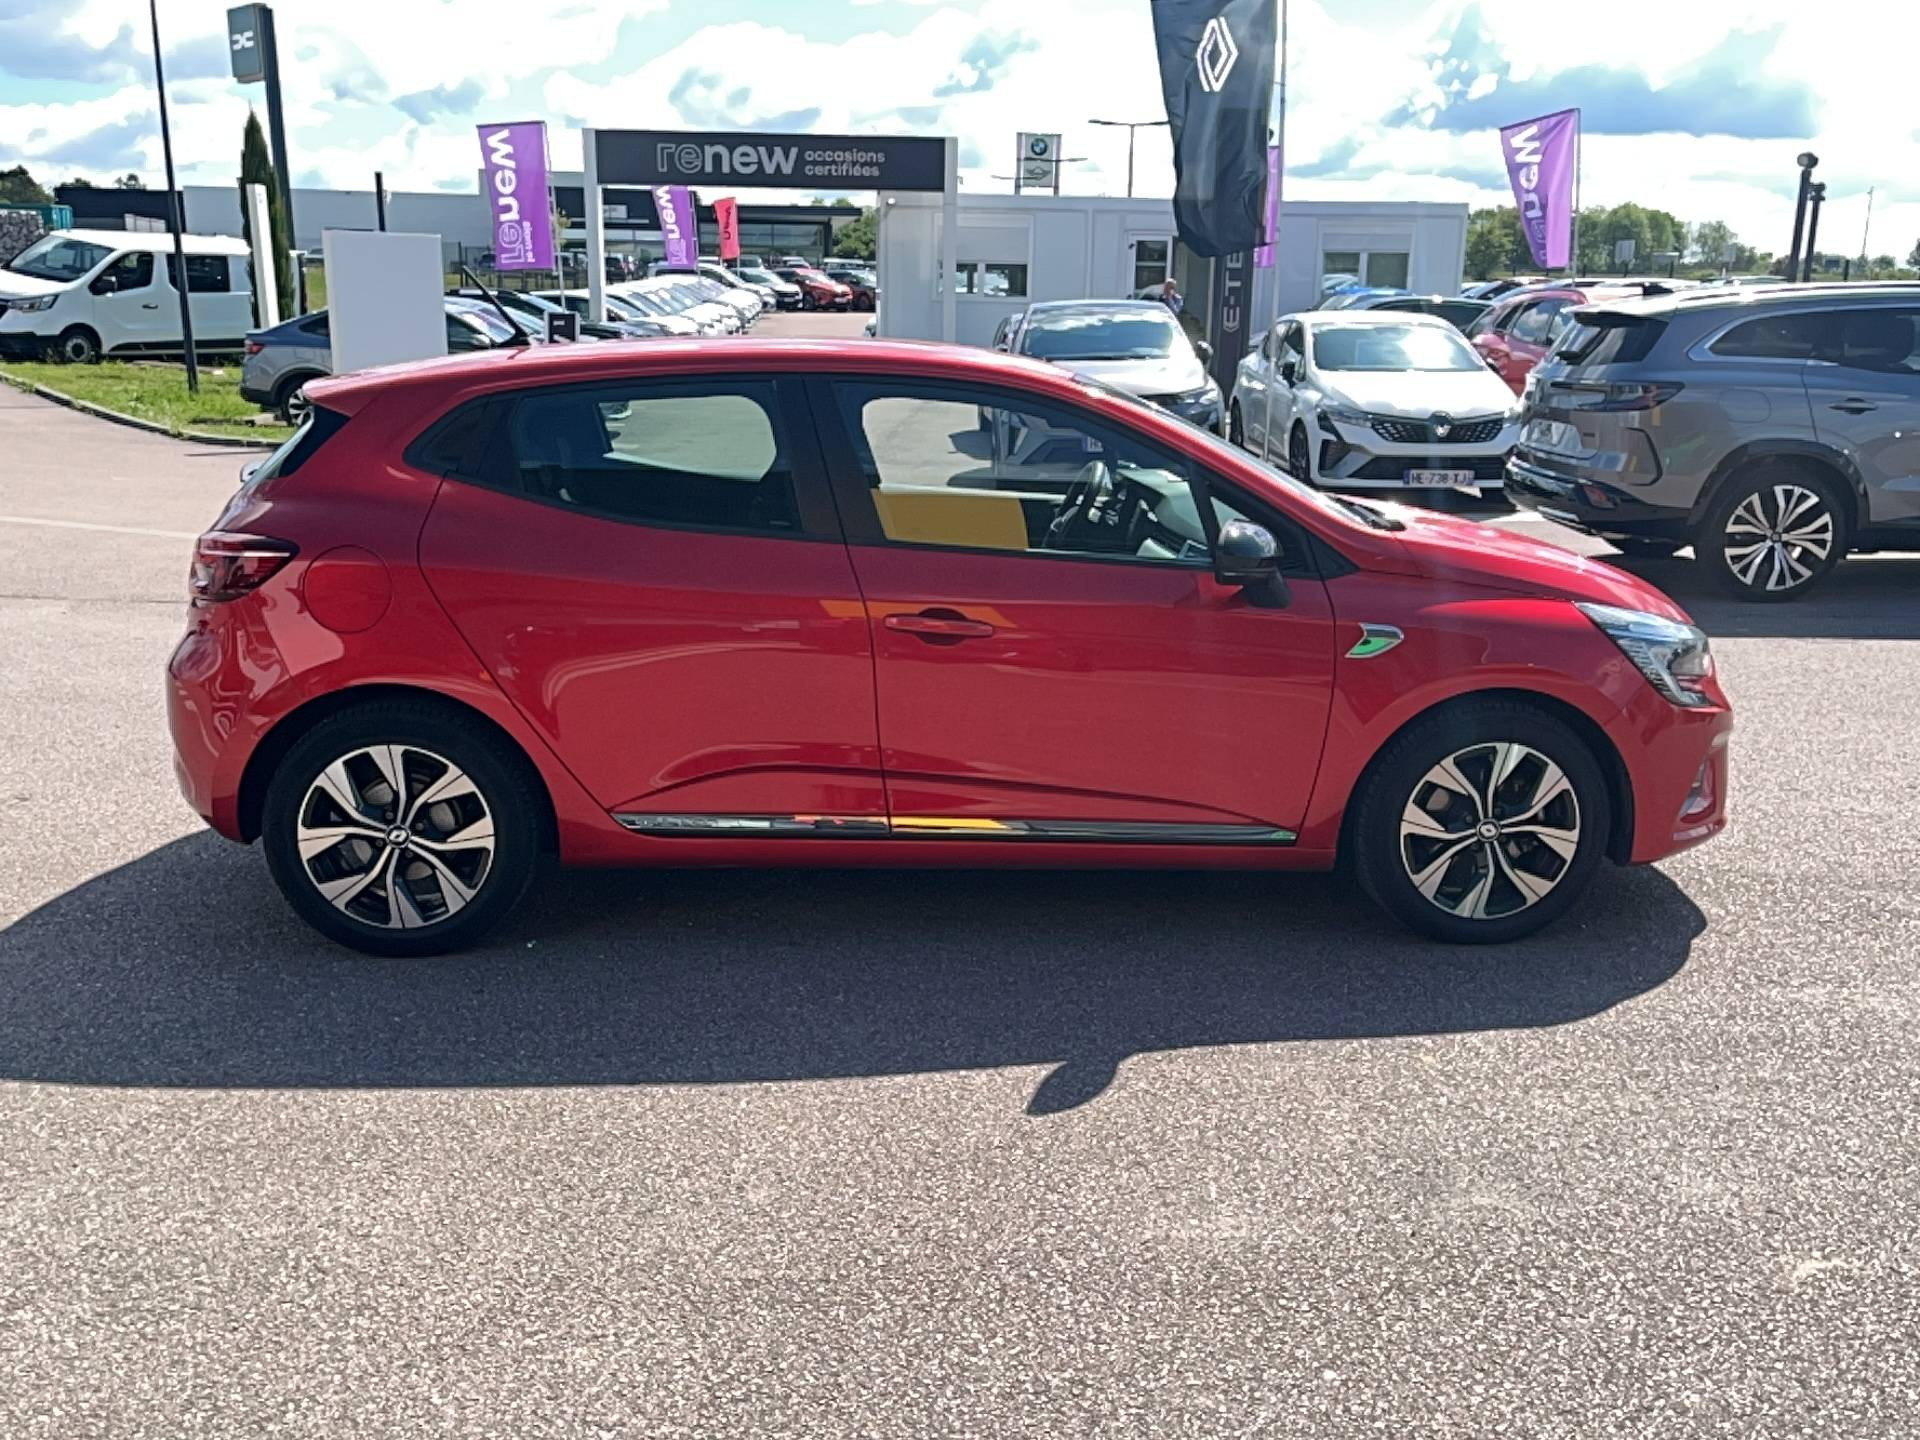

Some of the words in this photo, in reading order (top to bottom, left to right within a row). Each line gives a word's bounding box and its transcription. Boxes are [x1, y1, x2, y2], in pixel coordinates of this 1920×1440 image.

[656, 143, 798, 175] renew
[804, 148, 886, 163] occasions
[804, 163, 881, 176] certifiées
